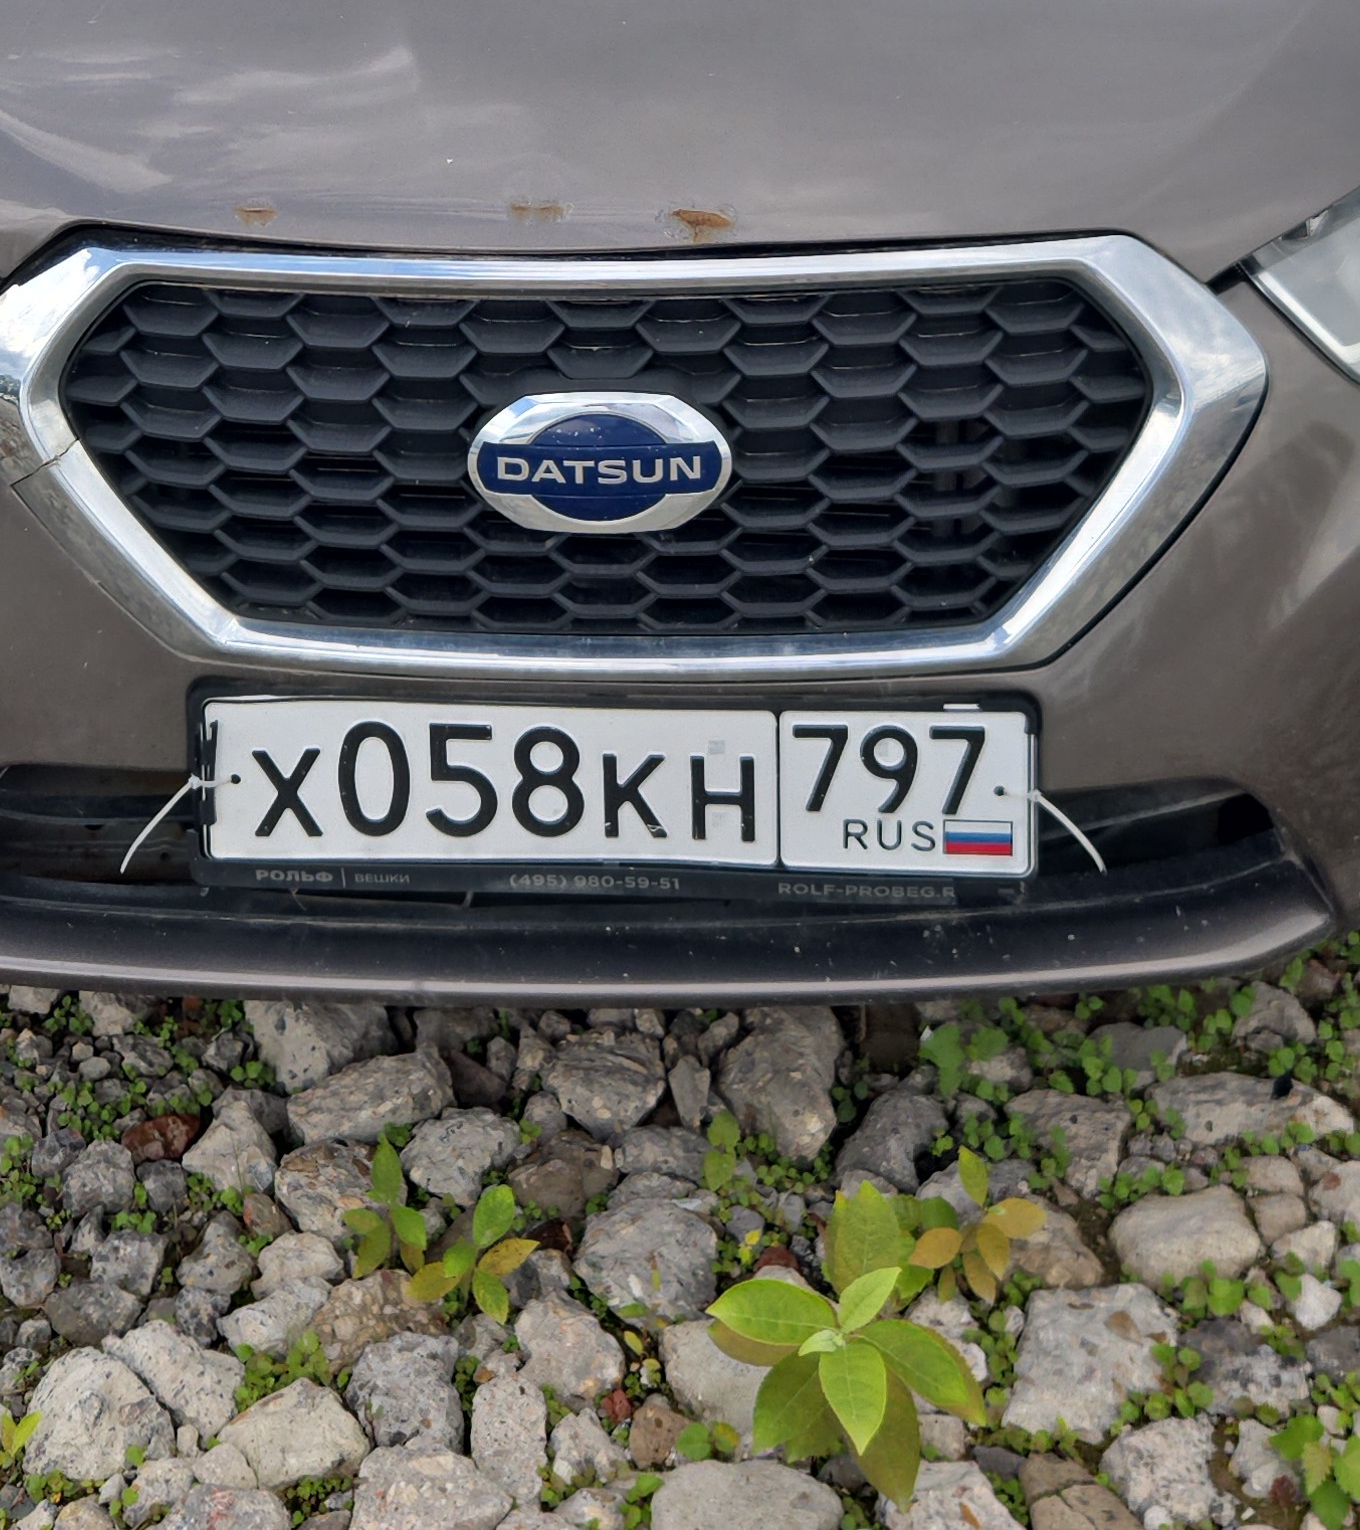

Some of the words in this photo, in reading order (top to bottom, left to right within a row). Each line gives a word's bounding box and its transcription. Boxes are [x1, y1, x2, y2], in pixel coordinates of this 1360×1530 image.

[497, 456, 701, 484] DATSUN
[792, 724, 986, 814] 797
[842, 819, 937, 852] RUS
[255, 870, 333, 883] РОЛЬФ
[354, 873, 410, 884] ВЕШКИ
[509, 874, 567, 888] (495)
[574, 875, 680, 890] 980-59-51
